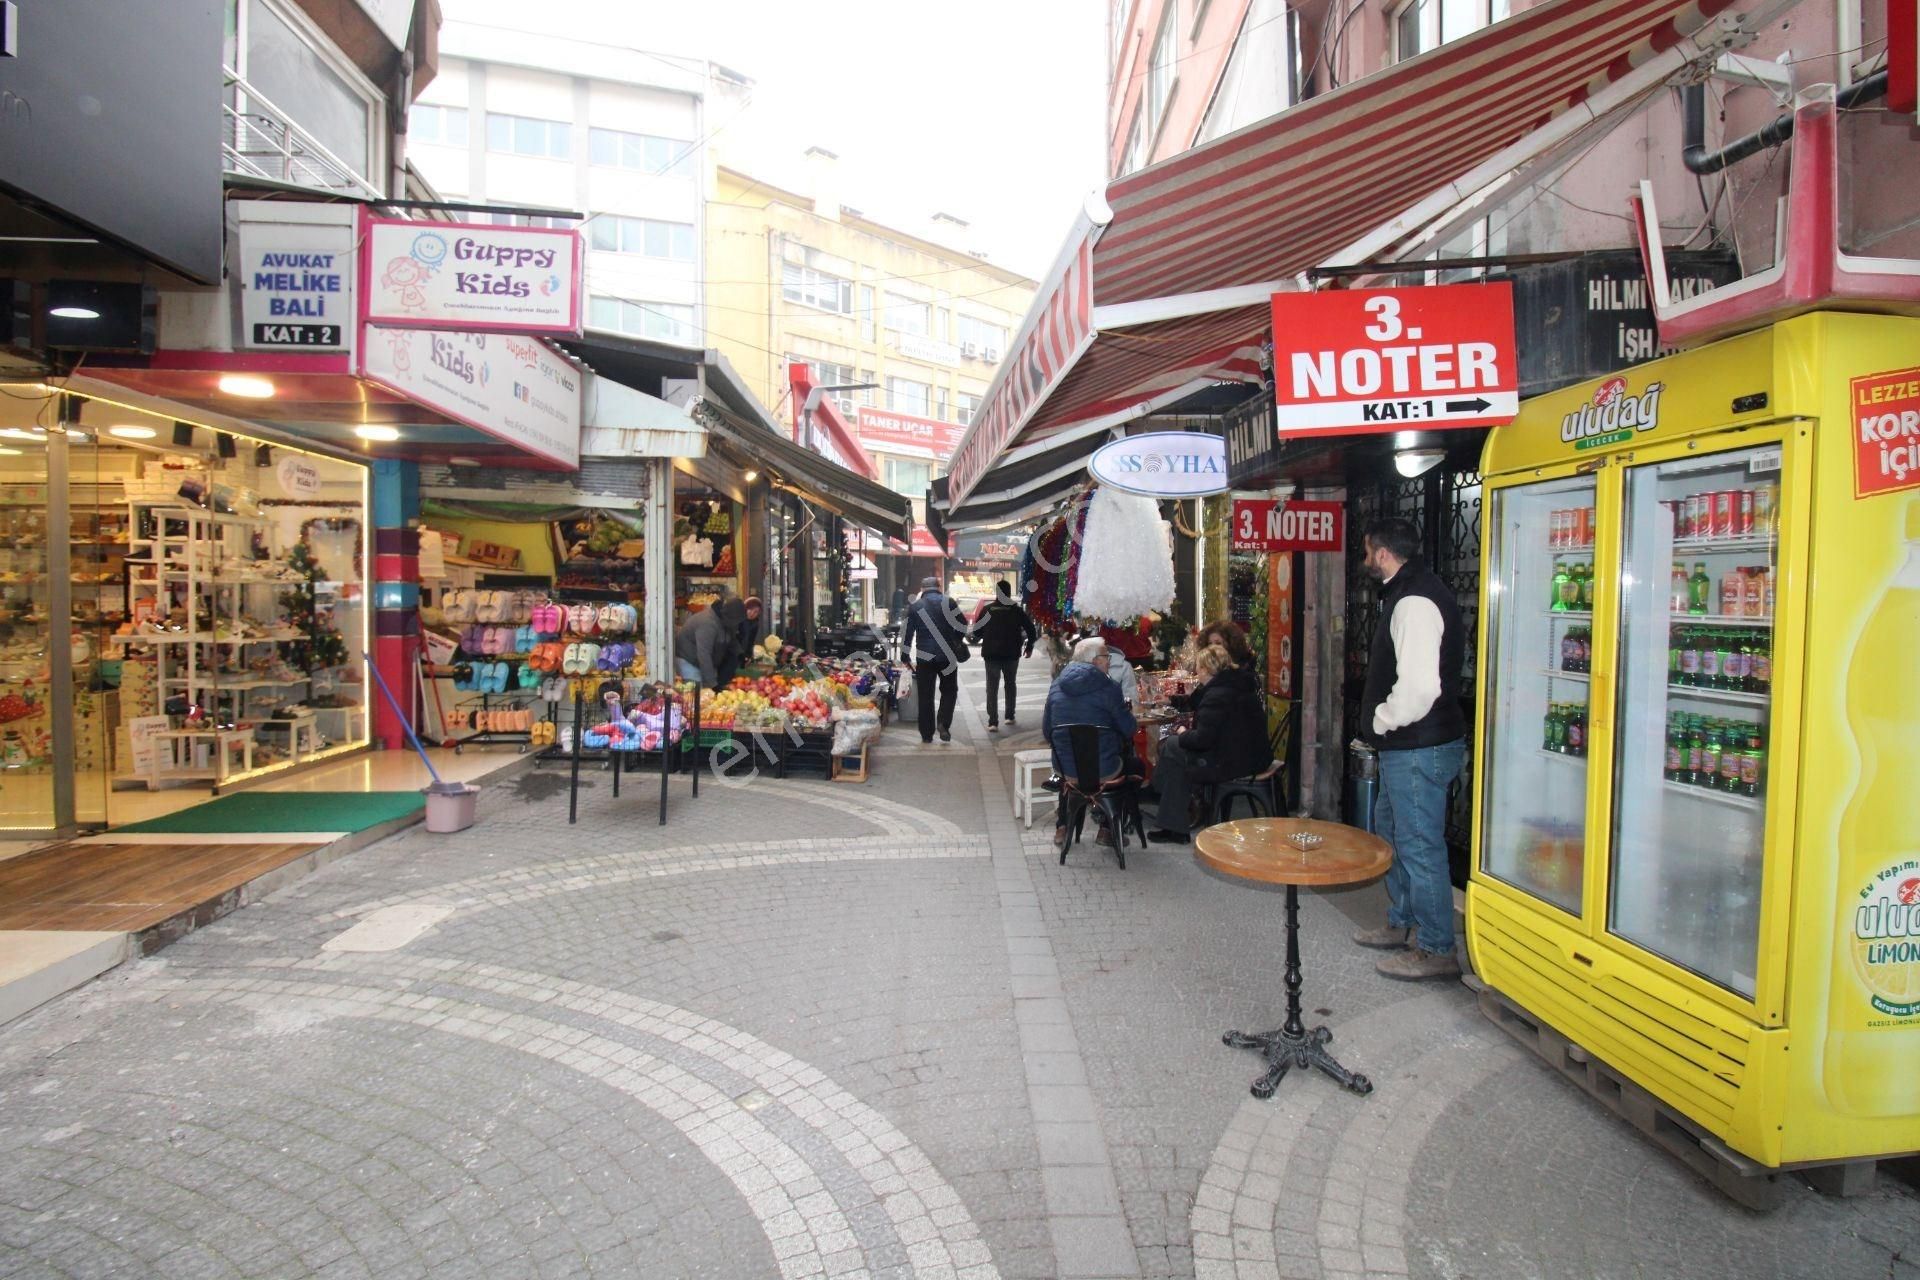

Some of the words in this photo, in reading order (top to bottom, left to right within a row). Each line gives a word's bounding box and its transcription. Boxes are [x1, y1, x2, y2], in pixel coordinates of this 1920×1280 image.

[261, 253, 334, 268] AVUKAT
[454, 237, 557, 268] Guppy
[254, 270, 340, 292] MELİKE
[455, 272, 530, 297] Kids
[1588, 274, 1647, 310] HİLMİ
[270, 295, 324, 317] BALİ
[1364, 295, 1422, 341] 3.
[263, 325, 303, 342] KAT
[321, 326, 332, 343] 2
[1291, 342, 1499, 399] NOTER
[862, 414, 901, 431] TANER
[1560, 381, 1662, 443] uludağ
[1229, 402, 1273, 466] HİLMİ
[1239, 510, 1259, 540] 3.
[1266, 510, 1334, 542] NOTER
[1859, 882, 1874, 899] Ev
